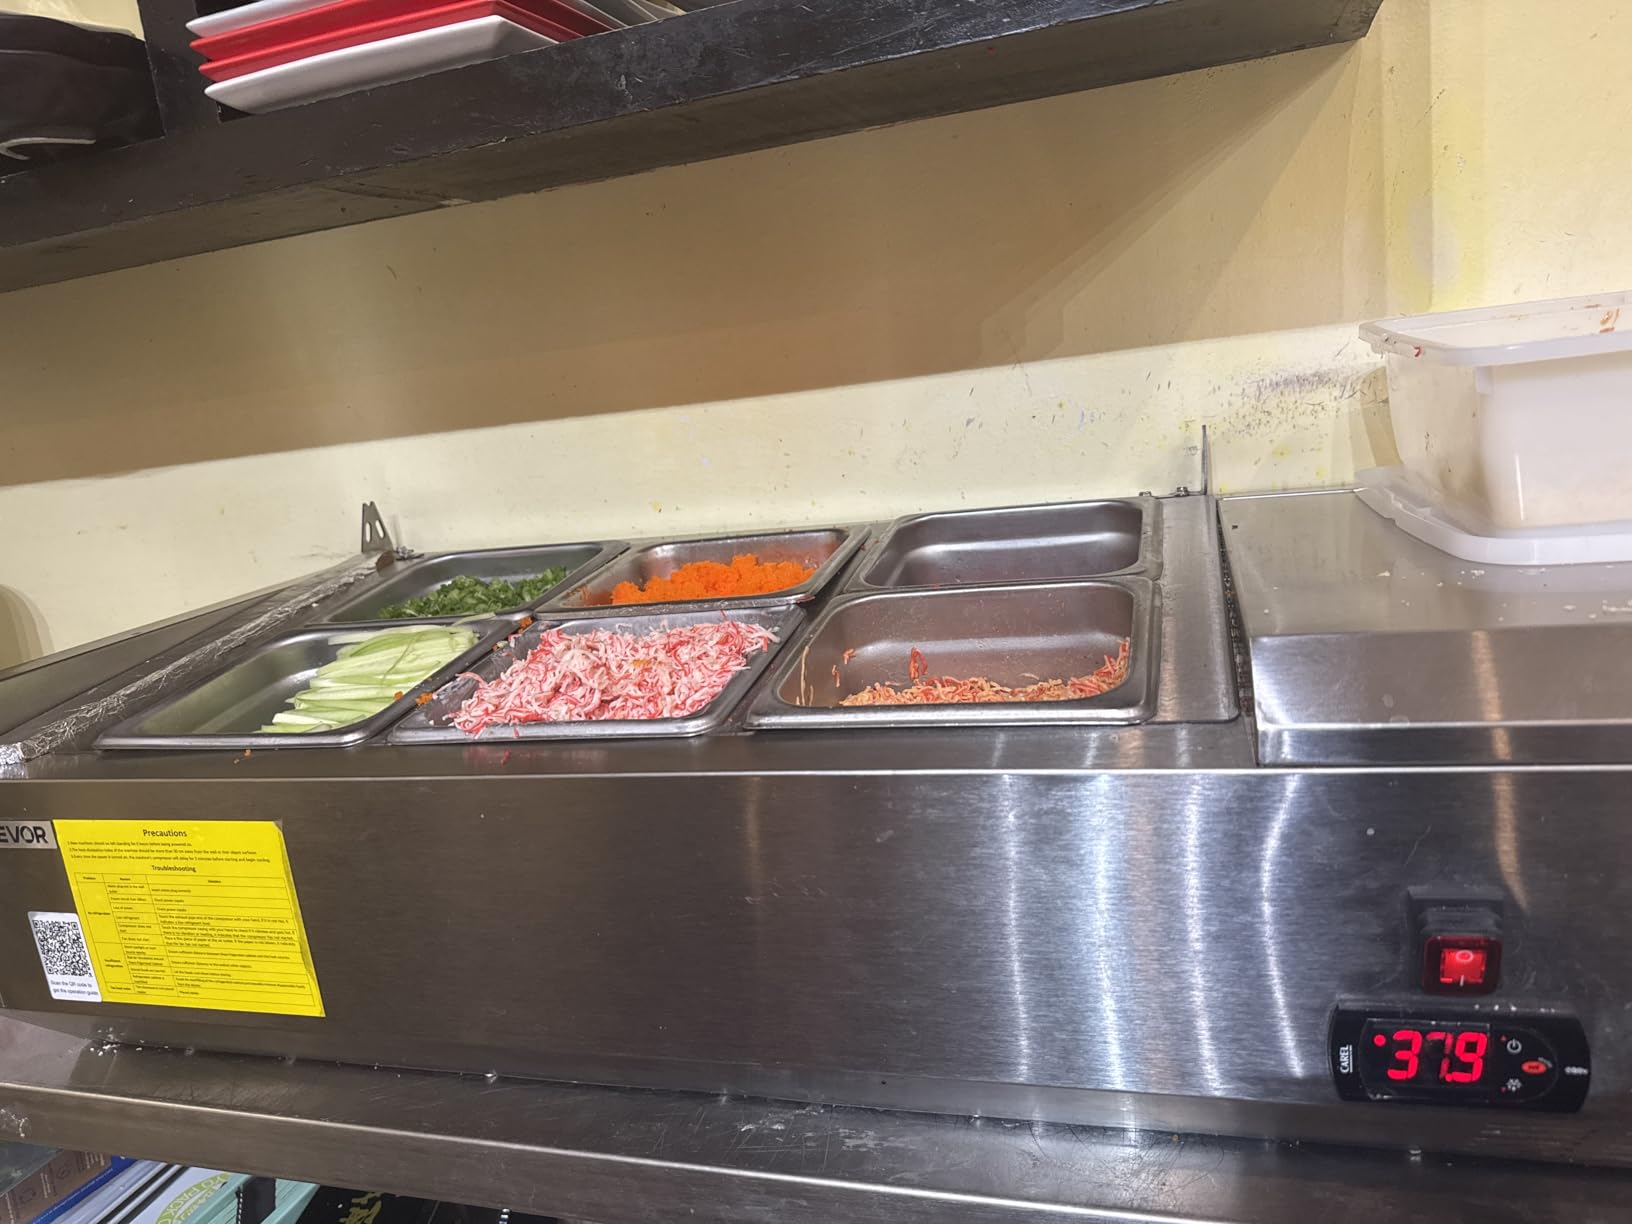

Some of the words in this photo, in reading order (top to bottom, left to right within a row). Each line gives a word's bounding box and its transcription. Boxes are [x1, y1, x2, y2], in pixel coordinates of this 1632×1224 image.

[142, 829, 188, 837] Precautions
[1340, 1044, 1350, 1074] CAREL
[1387, 1030, 1488, 1083] 37.9
